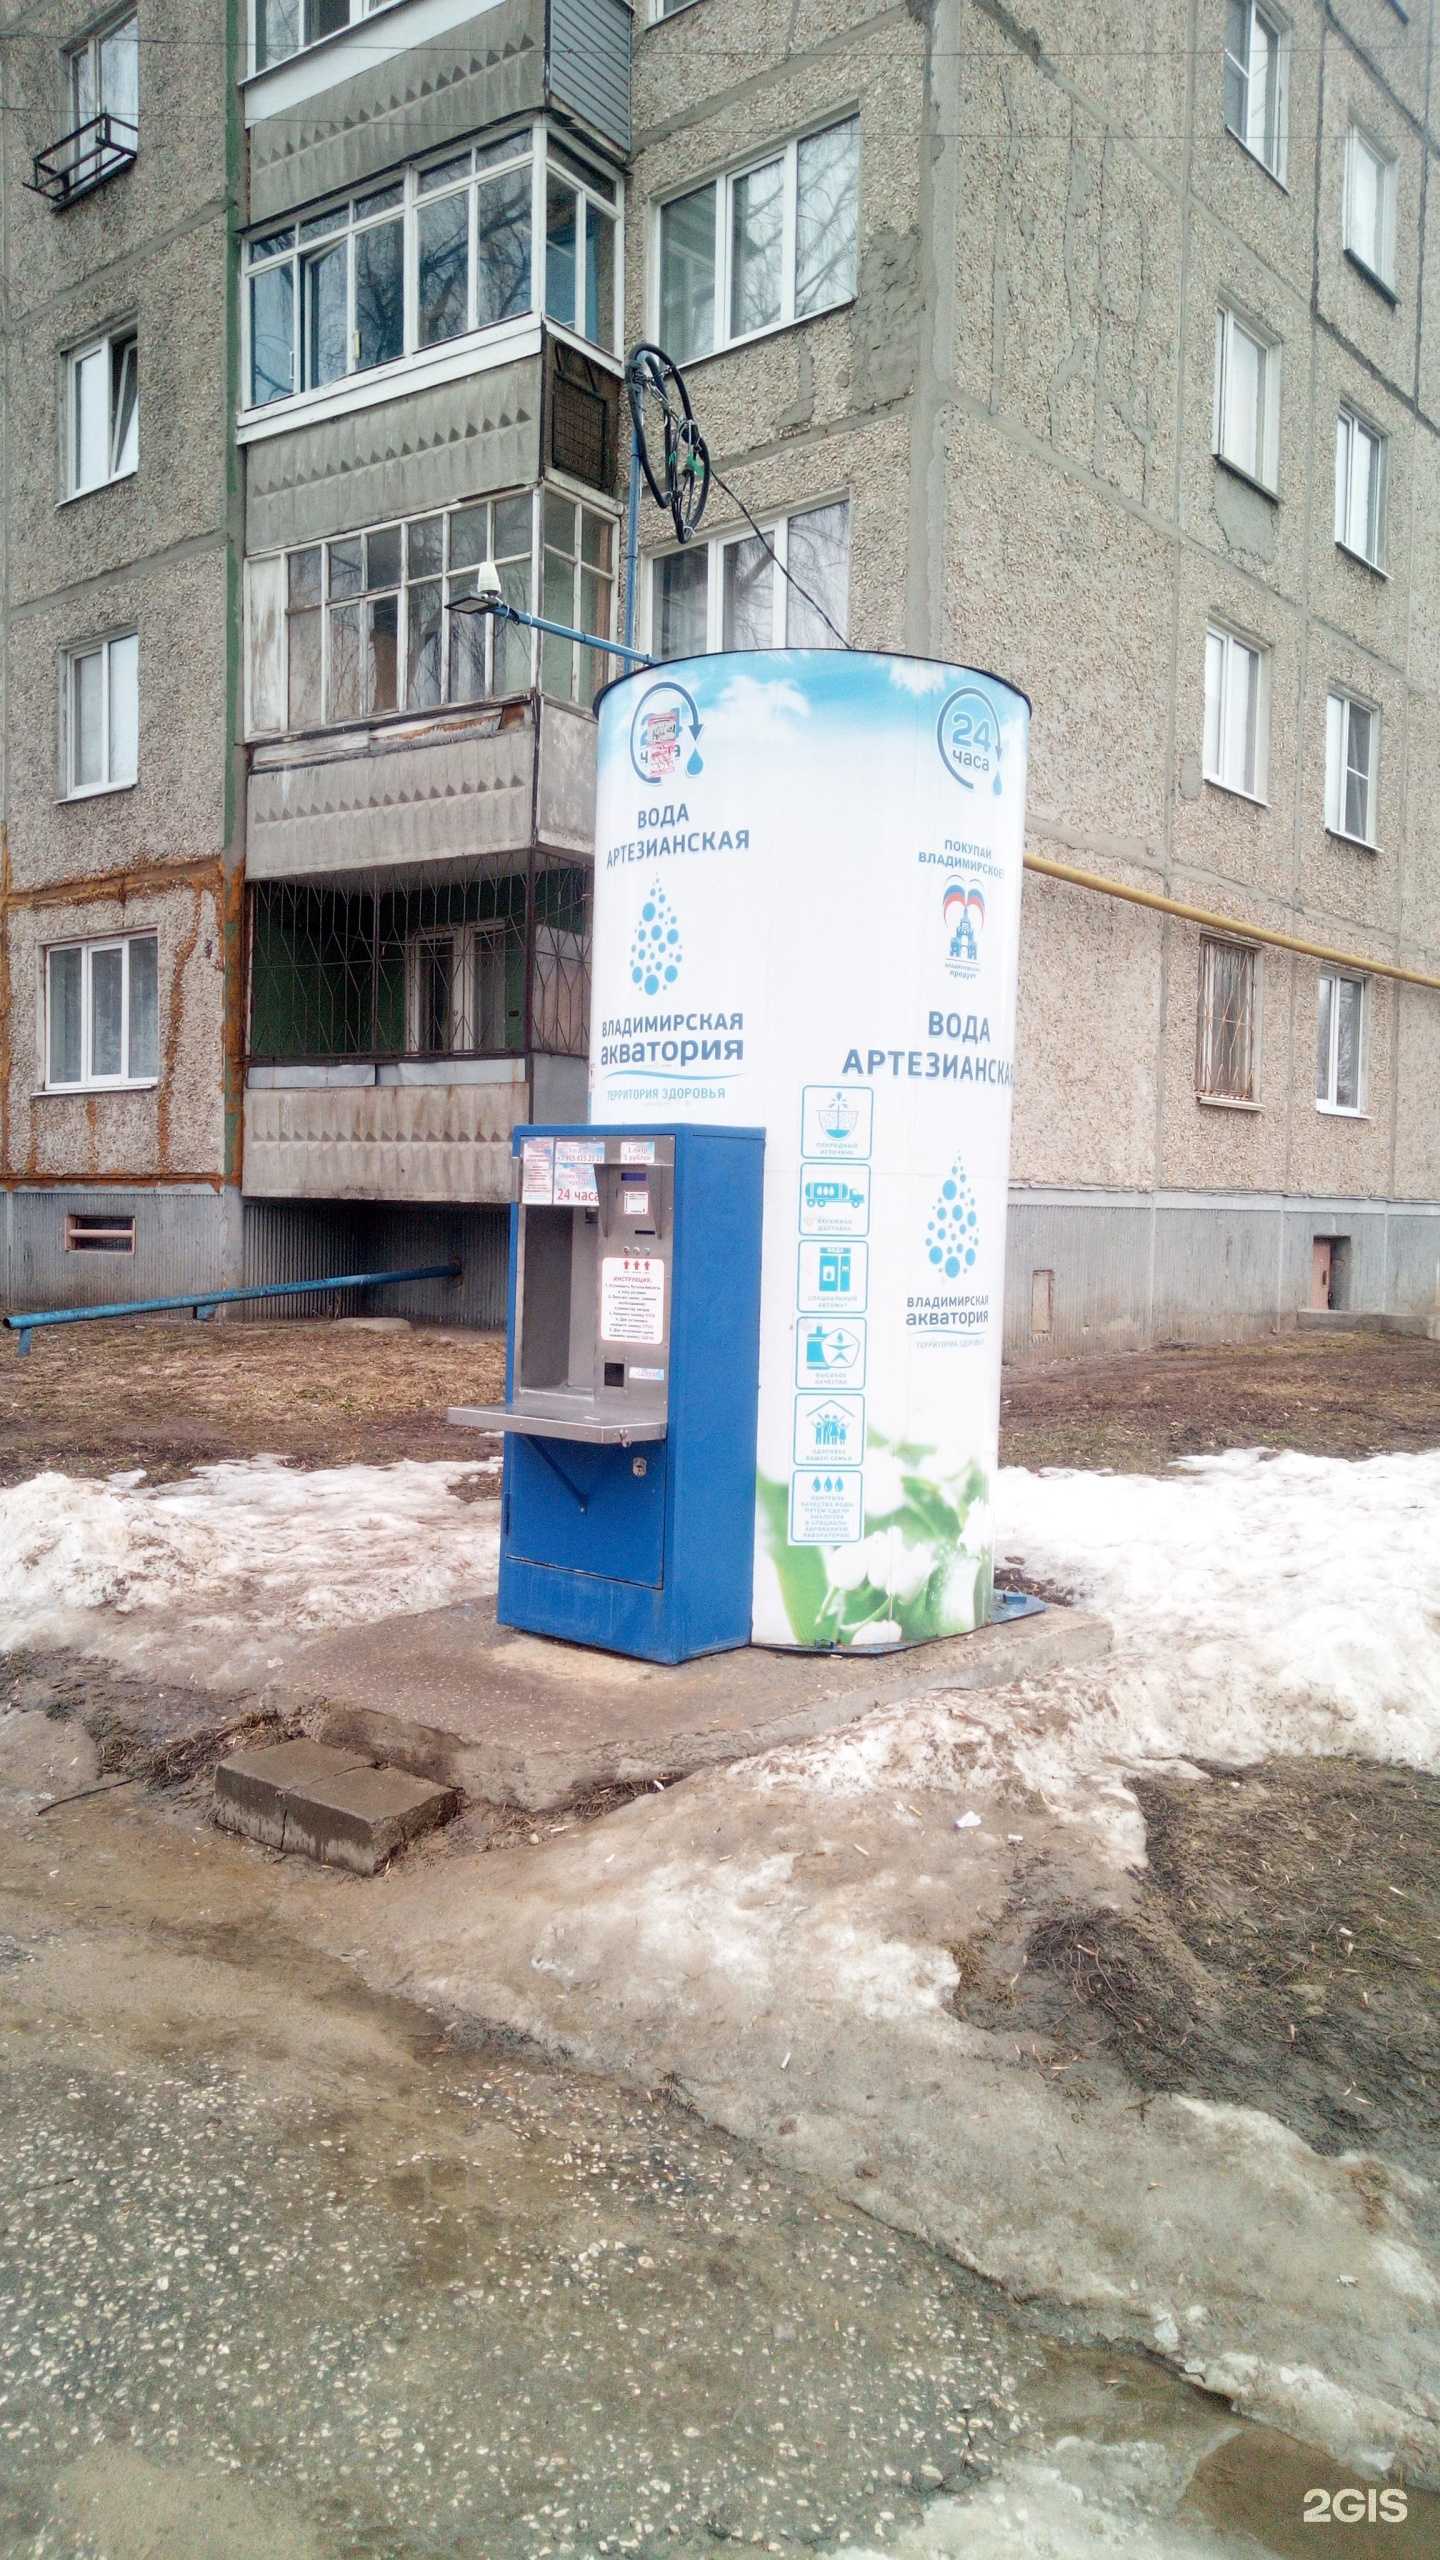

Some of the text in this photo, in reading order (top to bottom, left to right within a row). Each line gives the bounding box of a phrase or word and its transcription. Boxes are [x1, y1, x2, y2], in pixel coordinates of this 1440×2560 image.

[952, 713, 992, 752] 24
[952, 749, 990, 772] часа
[637, 803, 689, 829] ВОДА
[606, 829, 750, 870] АРТЕЗИАНСКАЯ
[918, 851, 1006, 880] ВЛАДИМИРСКОЕ
[602, 1012, 744, 1038] ВЛАДИМИРСКАЯ
[928, 1011, 991, 1044] ВОДА
[601, 1037, 744, 1066] акватория
[662, 1087, 726, 1100] ЗДОРОВЬЯ
[557, 1188, 571, 1201] 24
[907, 1295, 989, 1309] ВЛАДИМИРСКАЯ
[906, 1310, 989, 1327] акватория
